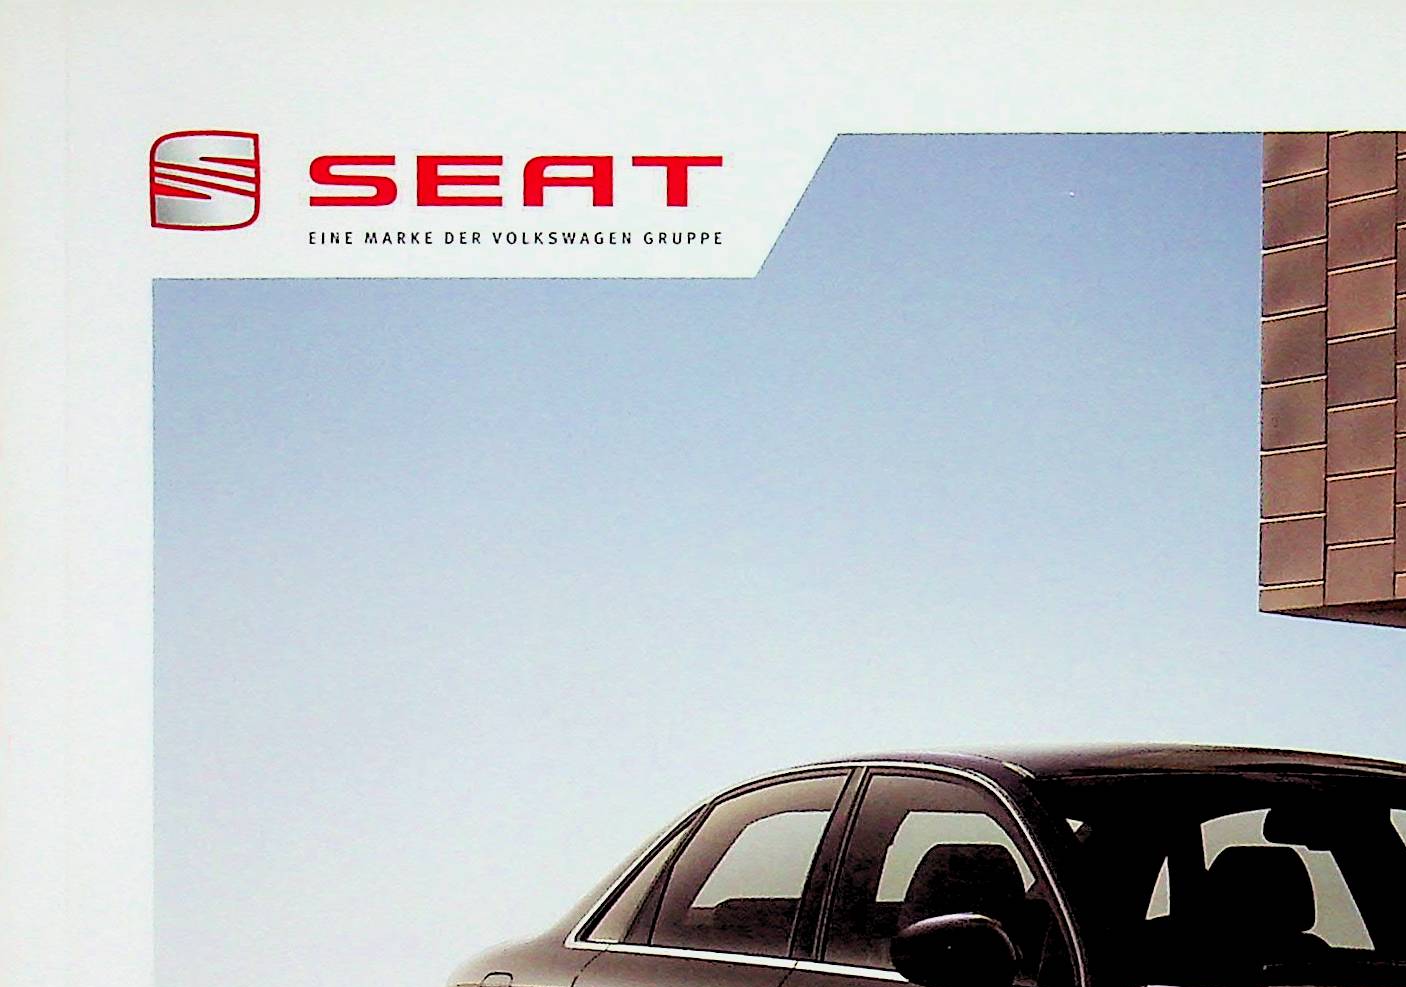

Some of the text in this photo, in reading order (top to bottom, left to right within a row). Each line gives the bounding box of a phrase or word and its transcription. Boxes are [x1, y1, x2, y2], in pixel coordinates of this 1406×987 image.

[309, 155, 723, 206] SEAT
[309, 231, 724, 245] EINE MARKE DER VOLKSWAGEN GRUPPE
